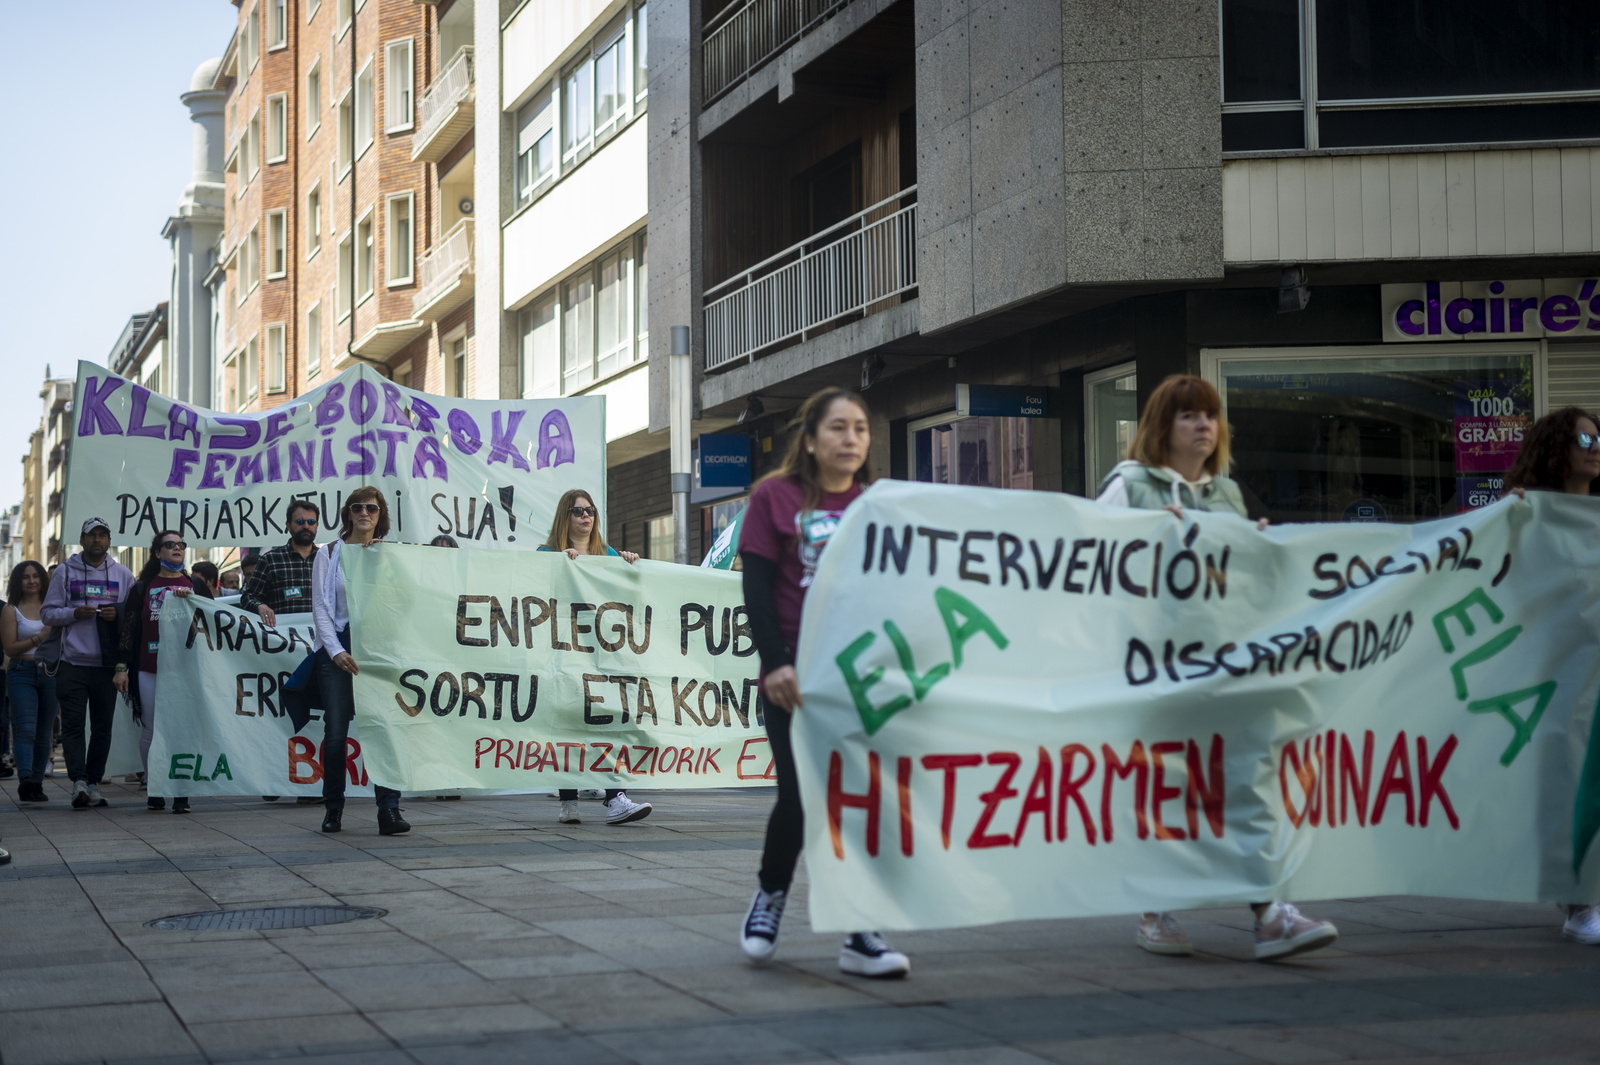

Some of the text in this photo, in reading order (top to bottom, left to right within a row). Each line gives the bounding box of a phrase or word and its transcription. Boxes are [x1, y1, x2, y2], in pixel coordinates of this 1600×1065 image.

[315, 378, 576, 473] BORROKA
[1020, 406, 1042, 415] kalea
[1026, 396, 1042, 404] Foru
[1470, 396, 1514, 417] TODO
[704, 455, 748, 464] DECATHLON
[1488, 479, 1504, 489] TOD
[430, 485, 517, 543] SUA!
[1468, 494, 1498, 507] GRA
[862, 522, 1231, 600] INTERVENCIÓN
[185, 607, 316, 655] ARABA
[455, 594, 758, 658] ENPLEGU PUB
[1124, 611, 1414, 686] DISCAPACIDAD
[834, 586, 1010, 737] ELA
[1431, 587, 1558, 767] ELA
[394, 668, 765, 729] SORTU ETA KONT
[168, 753, 234, 782] ELA
[474, 736, 722, 777] PRIBATIZAZIORIK
[826, 732, 1226, 861] HITZARMEN
